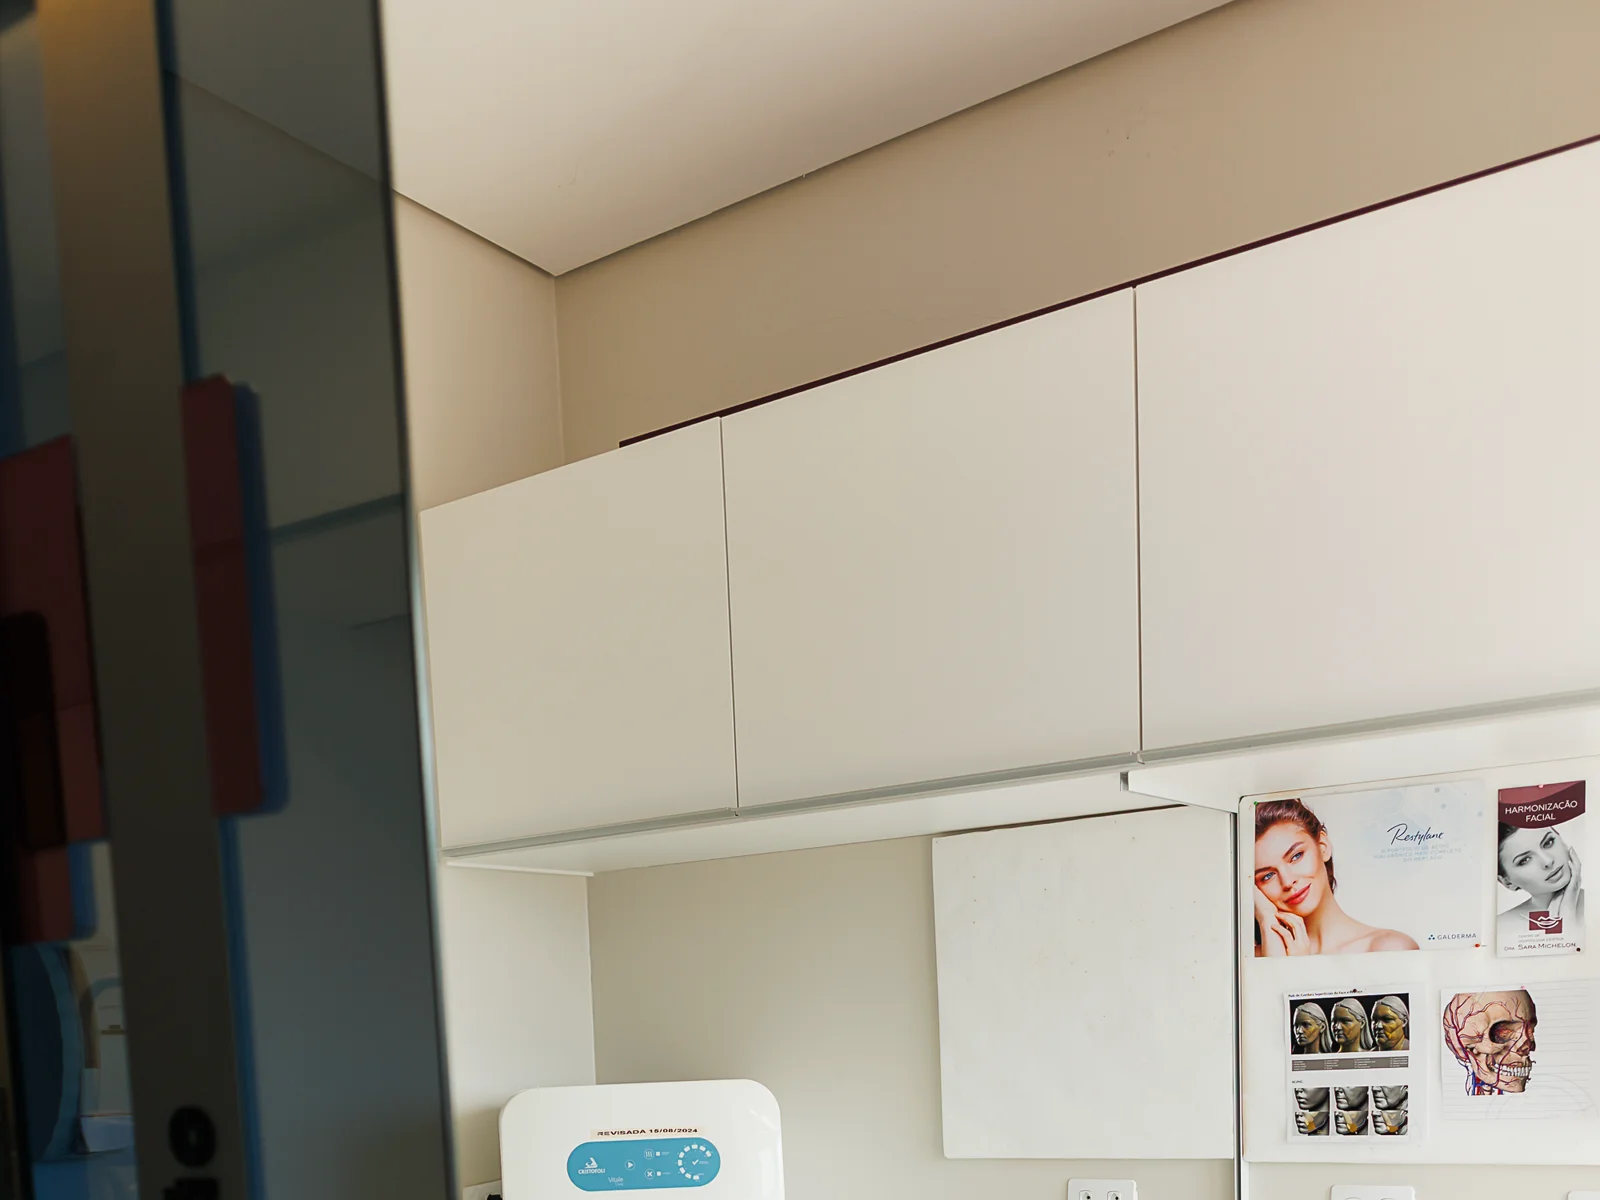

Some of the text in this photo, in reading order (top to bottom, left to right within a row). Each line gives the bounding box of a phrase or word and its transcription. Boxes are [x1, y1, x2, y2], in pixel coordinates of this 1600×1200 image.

[1505, 800, 1578, 814] HARMONIZAÇÃO
[1525, 813, 1556, 822] FACIAL
[1387, 823, 1444, 845] Restylane
